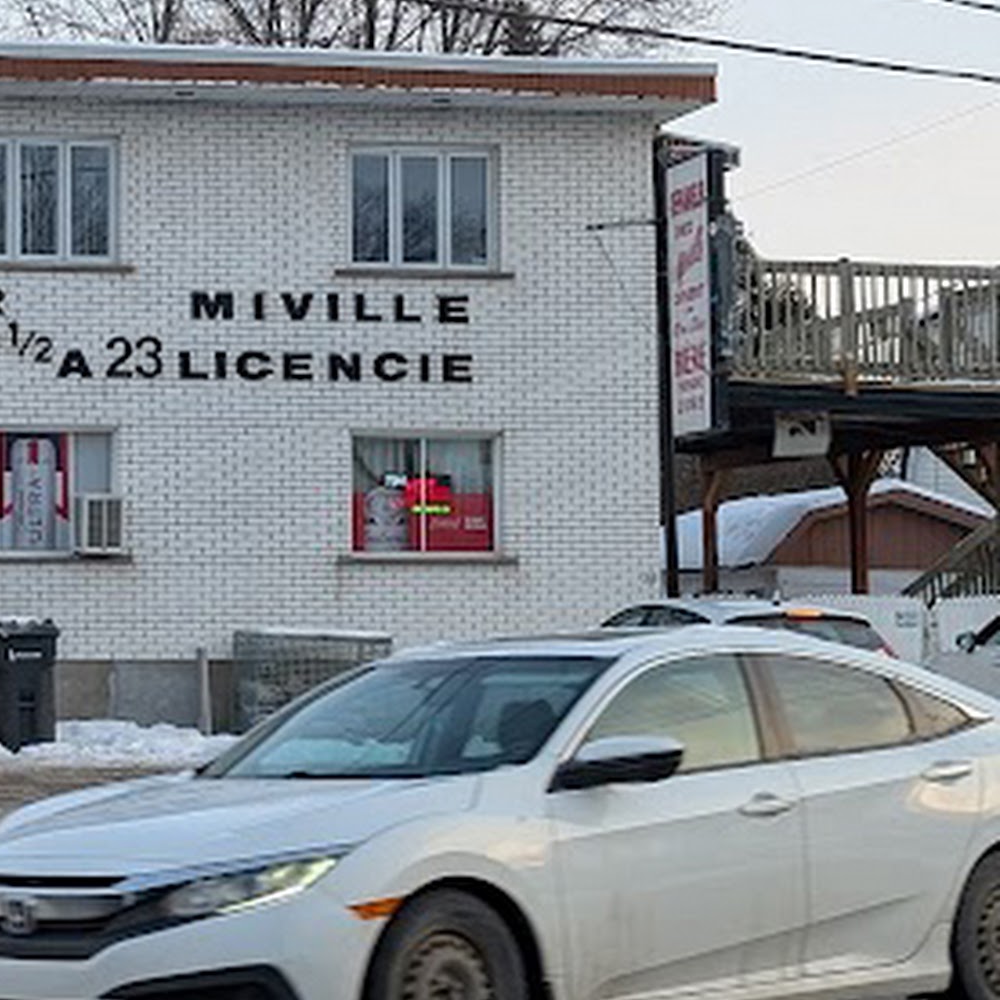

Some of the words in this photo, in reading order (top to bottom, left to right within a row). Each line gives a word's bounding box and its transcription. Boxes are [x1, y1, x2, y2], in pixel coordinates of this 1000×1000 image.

[190, 291, 471, 325] MIVILLE
[57, 349, 94, 379] A
[106, 336, 165, 380] 23
[179, 351, 475, 384] LICENCIE
